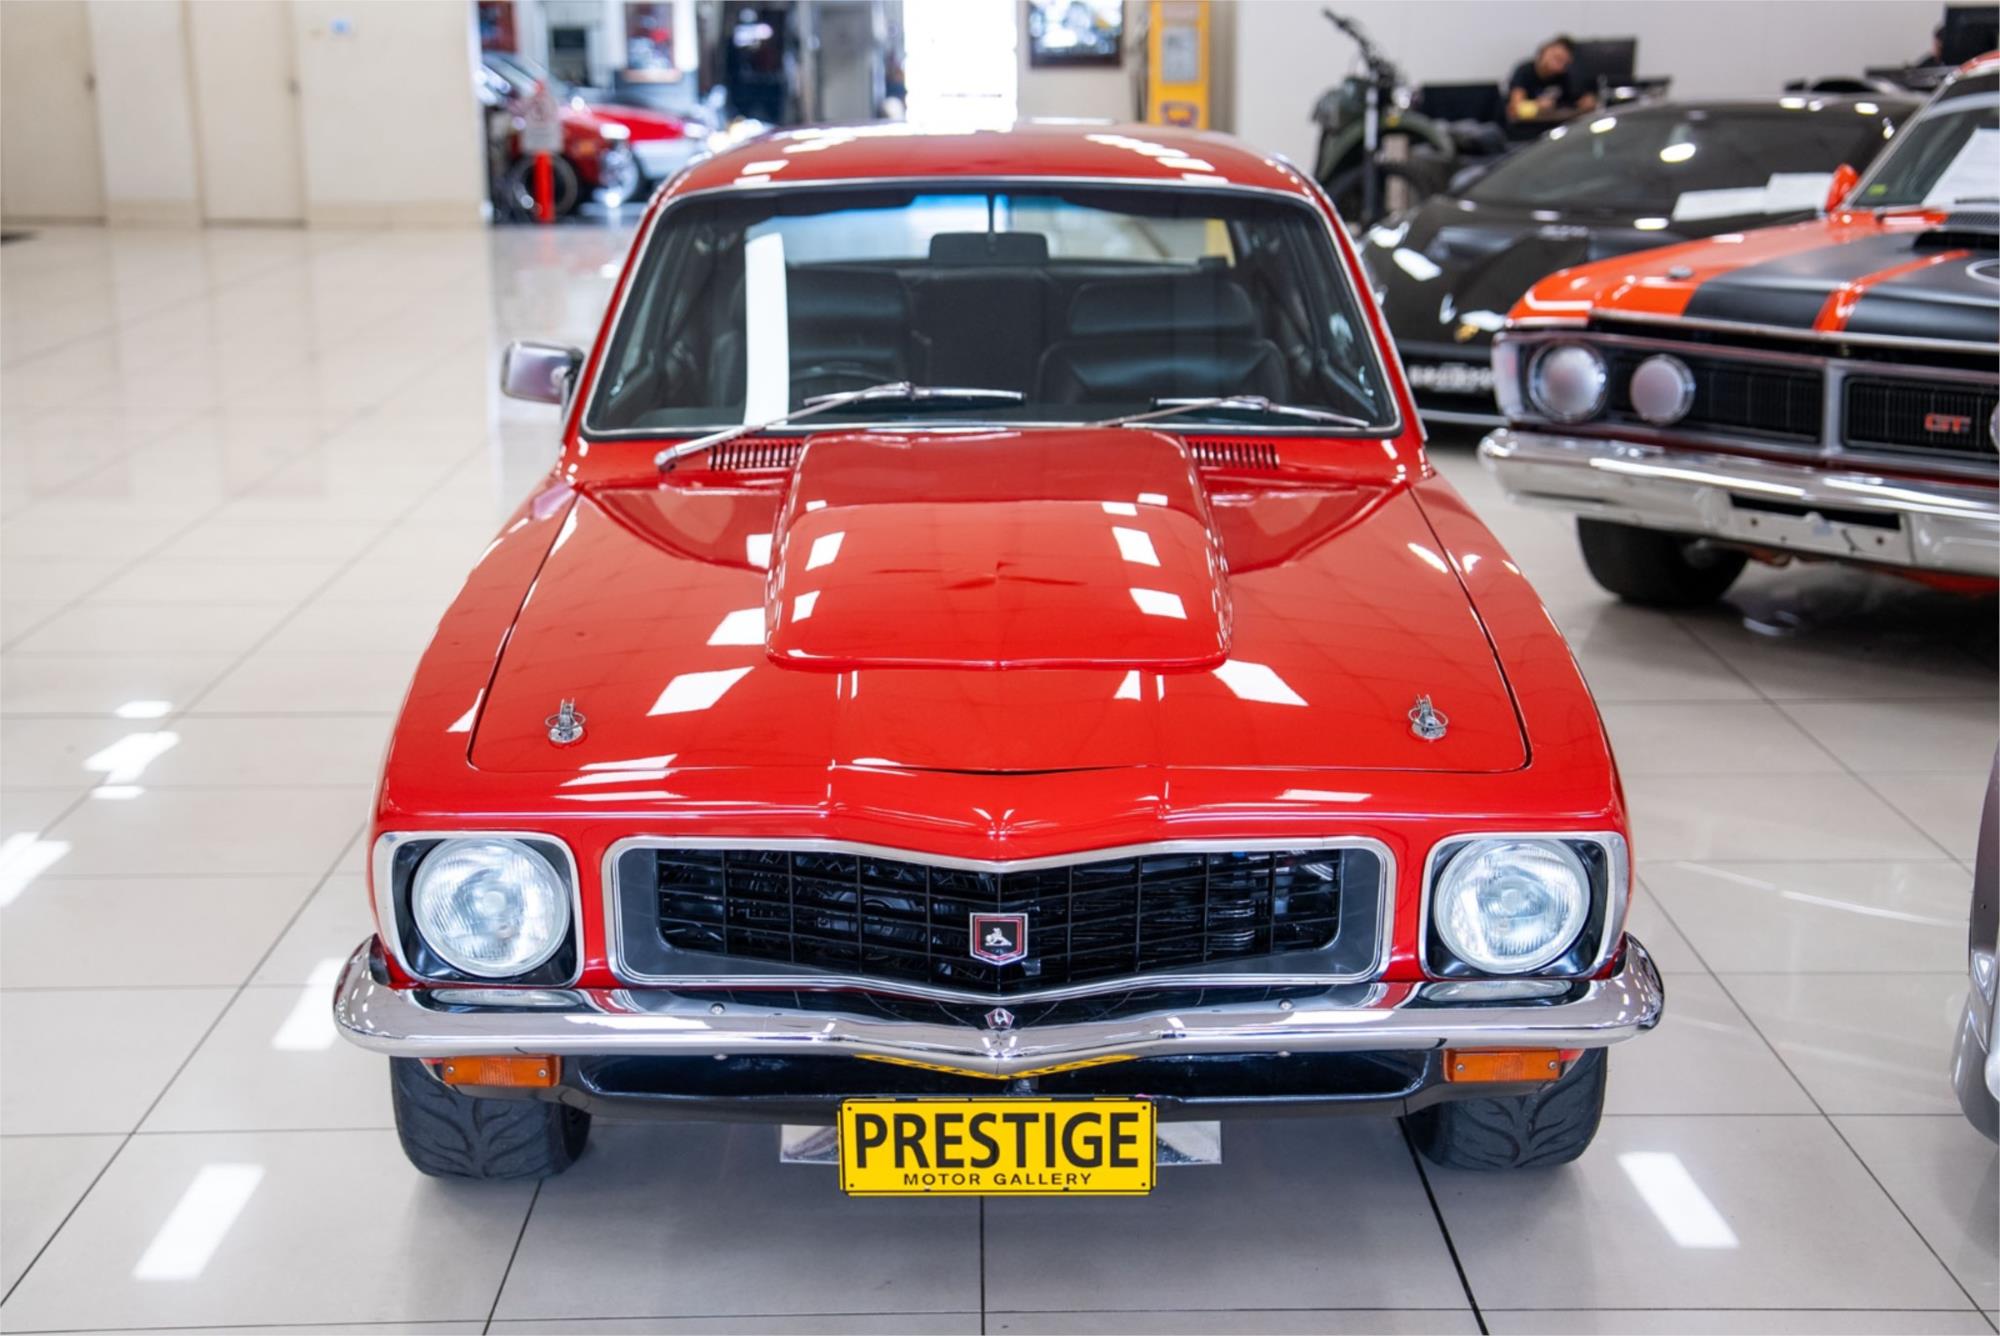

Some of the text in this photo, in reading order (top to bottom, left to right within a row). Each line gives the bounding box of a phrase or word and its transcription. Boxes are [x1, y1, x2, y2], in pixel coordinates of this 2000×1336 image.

[1924, 413, 1972, 433] GT
[855, 1112, 1139, 1169] PRESTIGE
[903, 1172, 1093, 1186] MOTOR GALLERY
